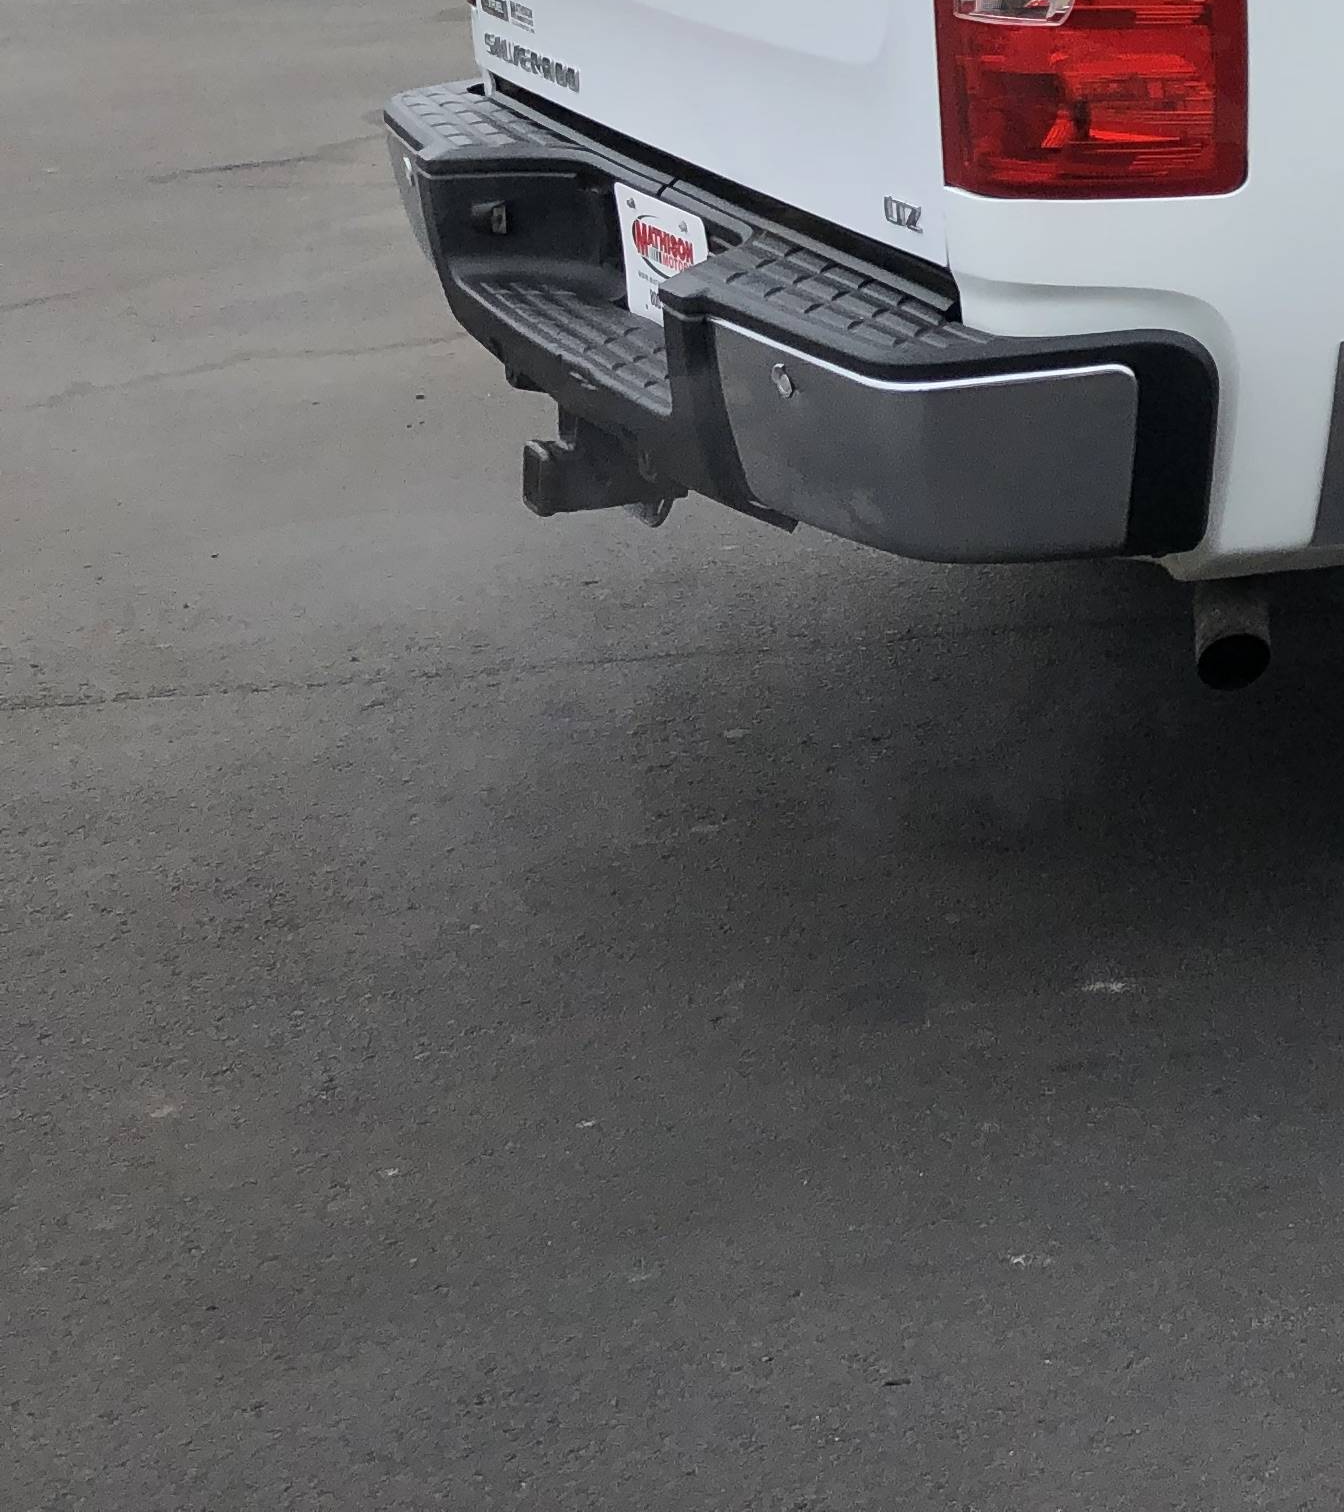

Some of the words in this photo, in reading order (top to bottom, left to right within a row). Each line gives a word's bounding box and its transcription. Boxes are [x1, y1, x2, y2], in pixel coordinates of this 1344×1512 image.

[484, 33, 580, 93] SILVERADO
[884, 196, 923, 234] LTZ
[634, 219, 694, 265] MATHISON
